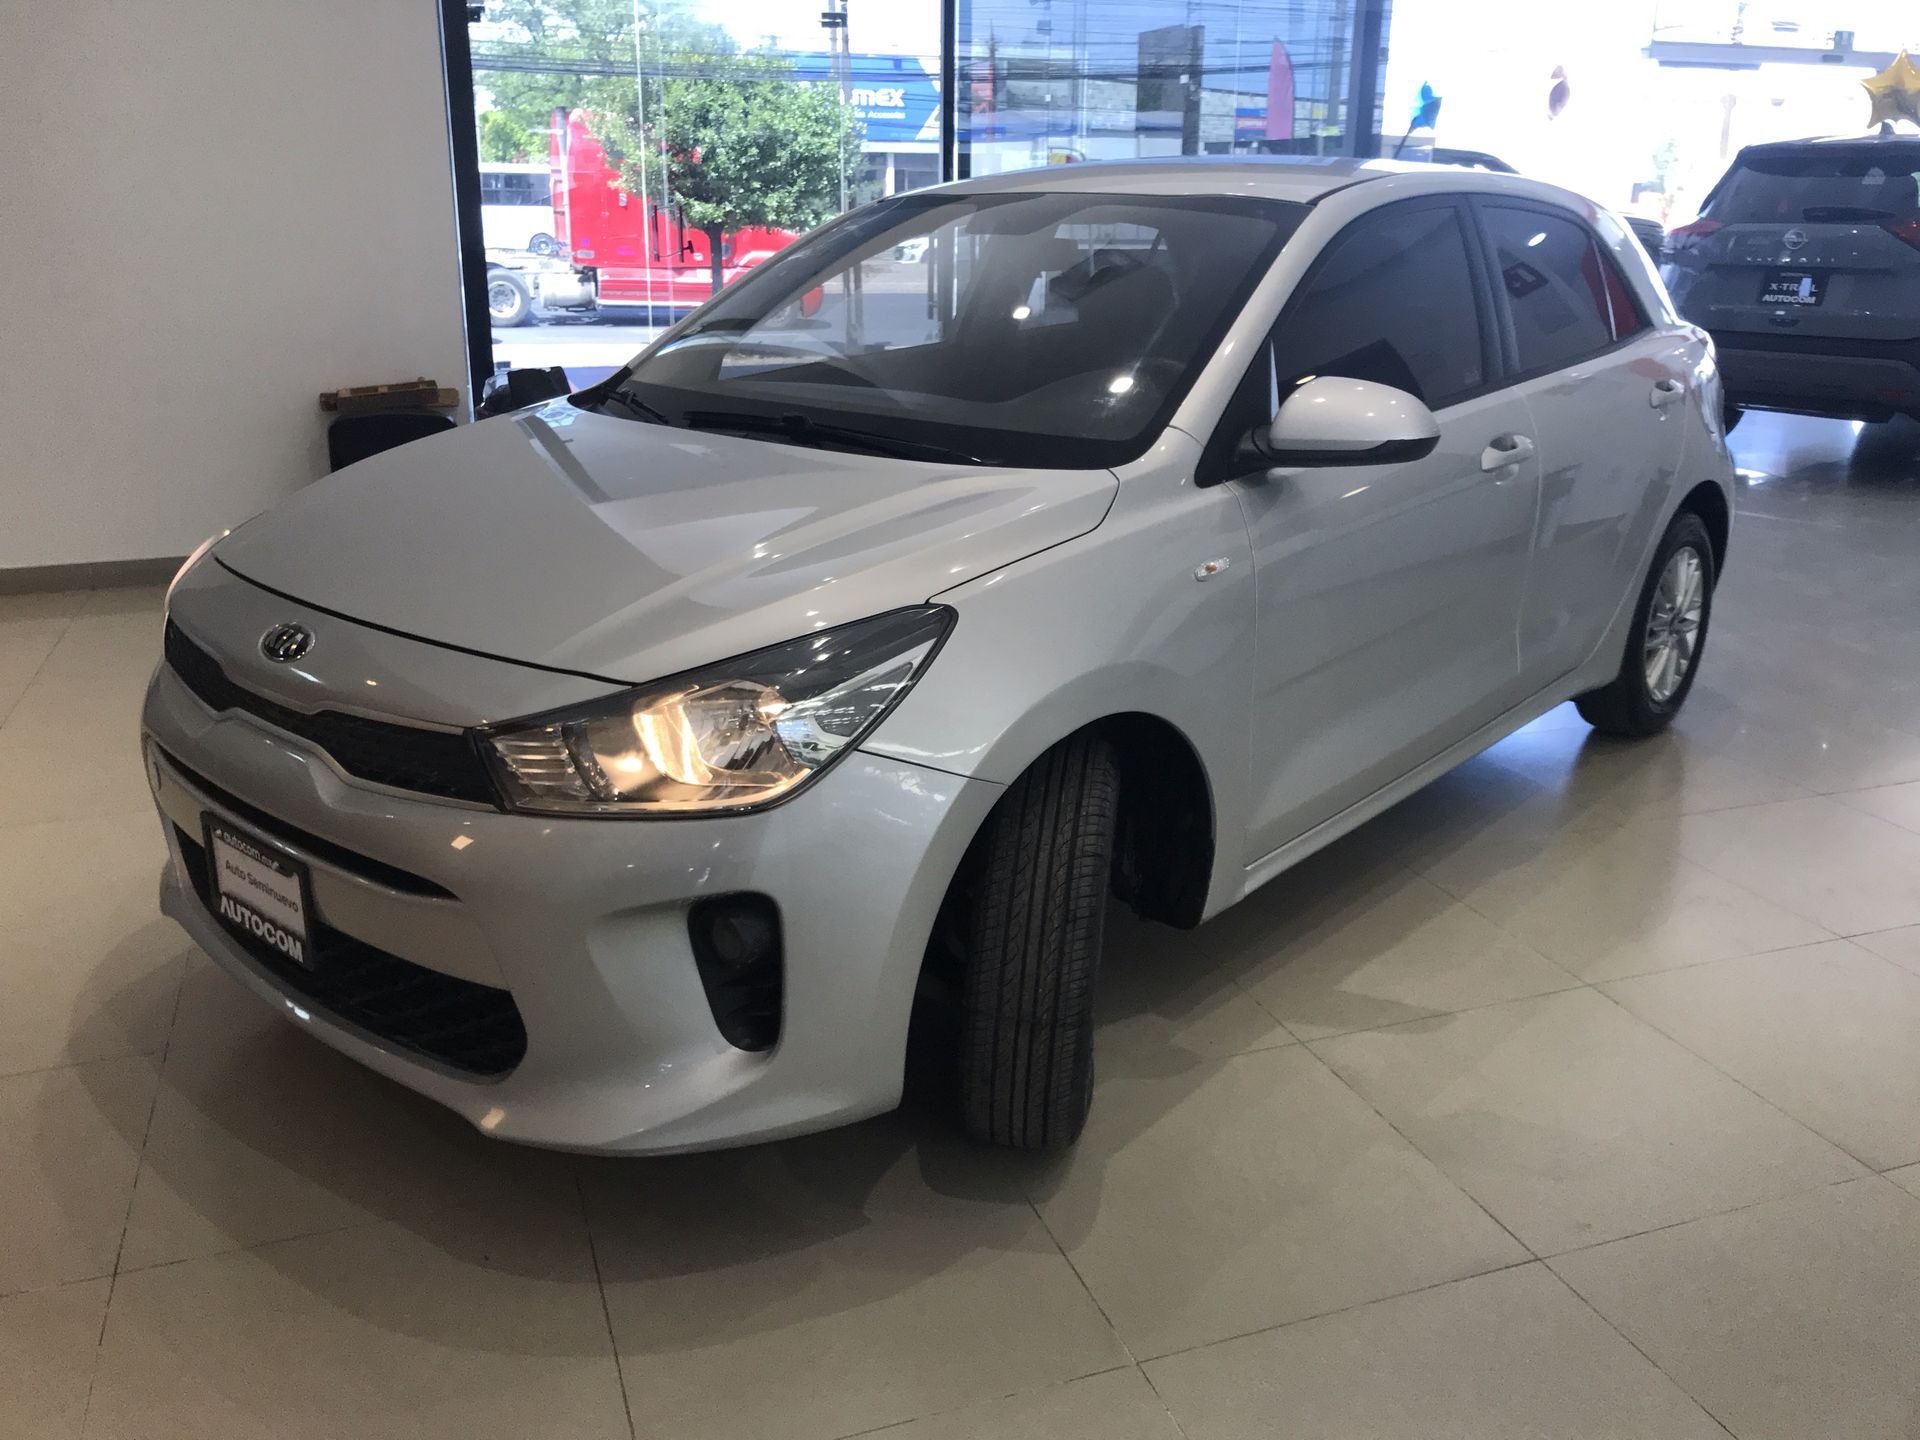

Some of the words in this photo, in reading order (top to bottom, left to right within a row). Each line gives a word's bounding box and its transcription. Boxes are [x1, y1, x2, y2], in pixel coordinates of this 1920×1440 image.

[1762, 294, 1817, 304] AUTOCOM
[1769, 283, 1819, 292] X-TRL
[225, 859, 246, 881] Auto
[247, 872, 299, 913] Seminuevo
[220, 895, 304, 964] AUTOCOM
